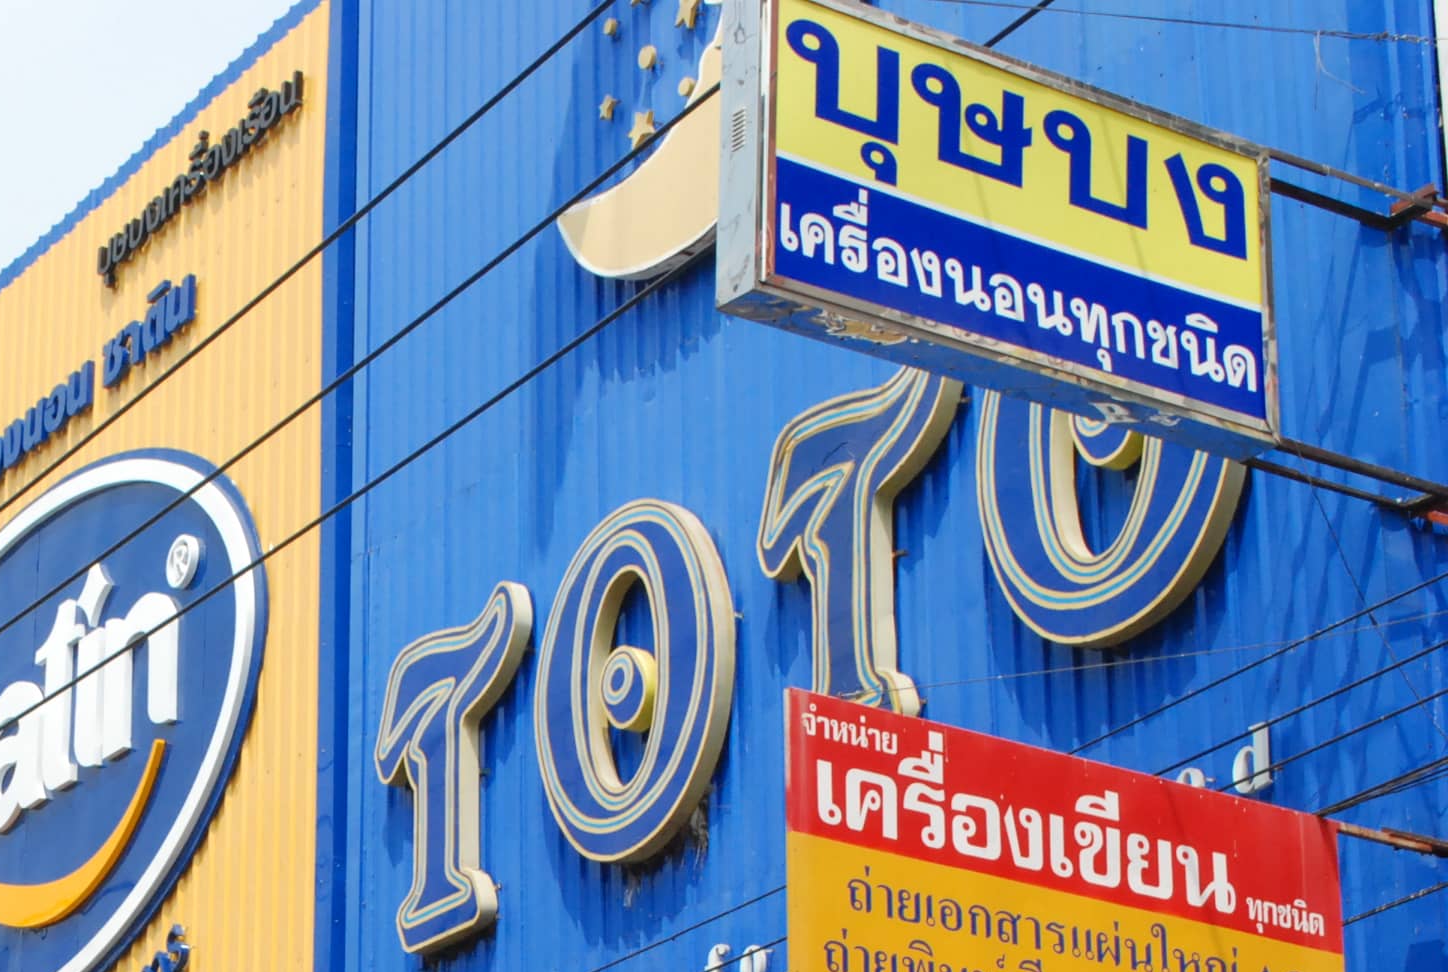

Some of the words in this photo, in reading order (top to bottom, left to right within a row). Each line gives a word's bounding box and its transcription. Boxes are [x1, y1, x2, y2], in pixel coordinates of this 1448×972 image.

[785, 18, 1249, 262] บุษบง
[779, 187, 1258, 393] เครื่องนอนทุกชนิด
[800, 703, 898, 756] จำหน่าย
[816, 731, 1237, 914] เครื่องเขียน
[1245, 893, 1326, 938] ทุกชนิด
